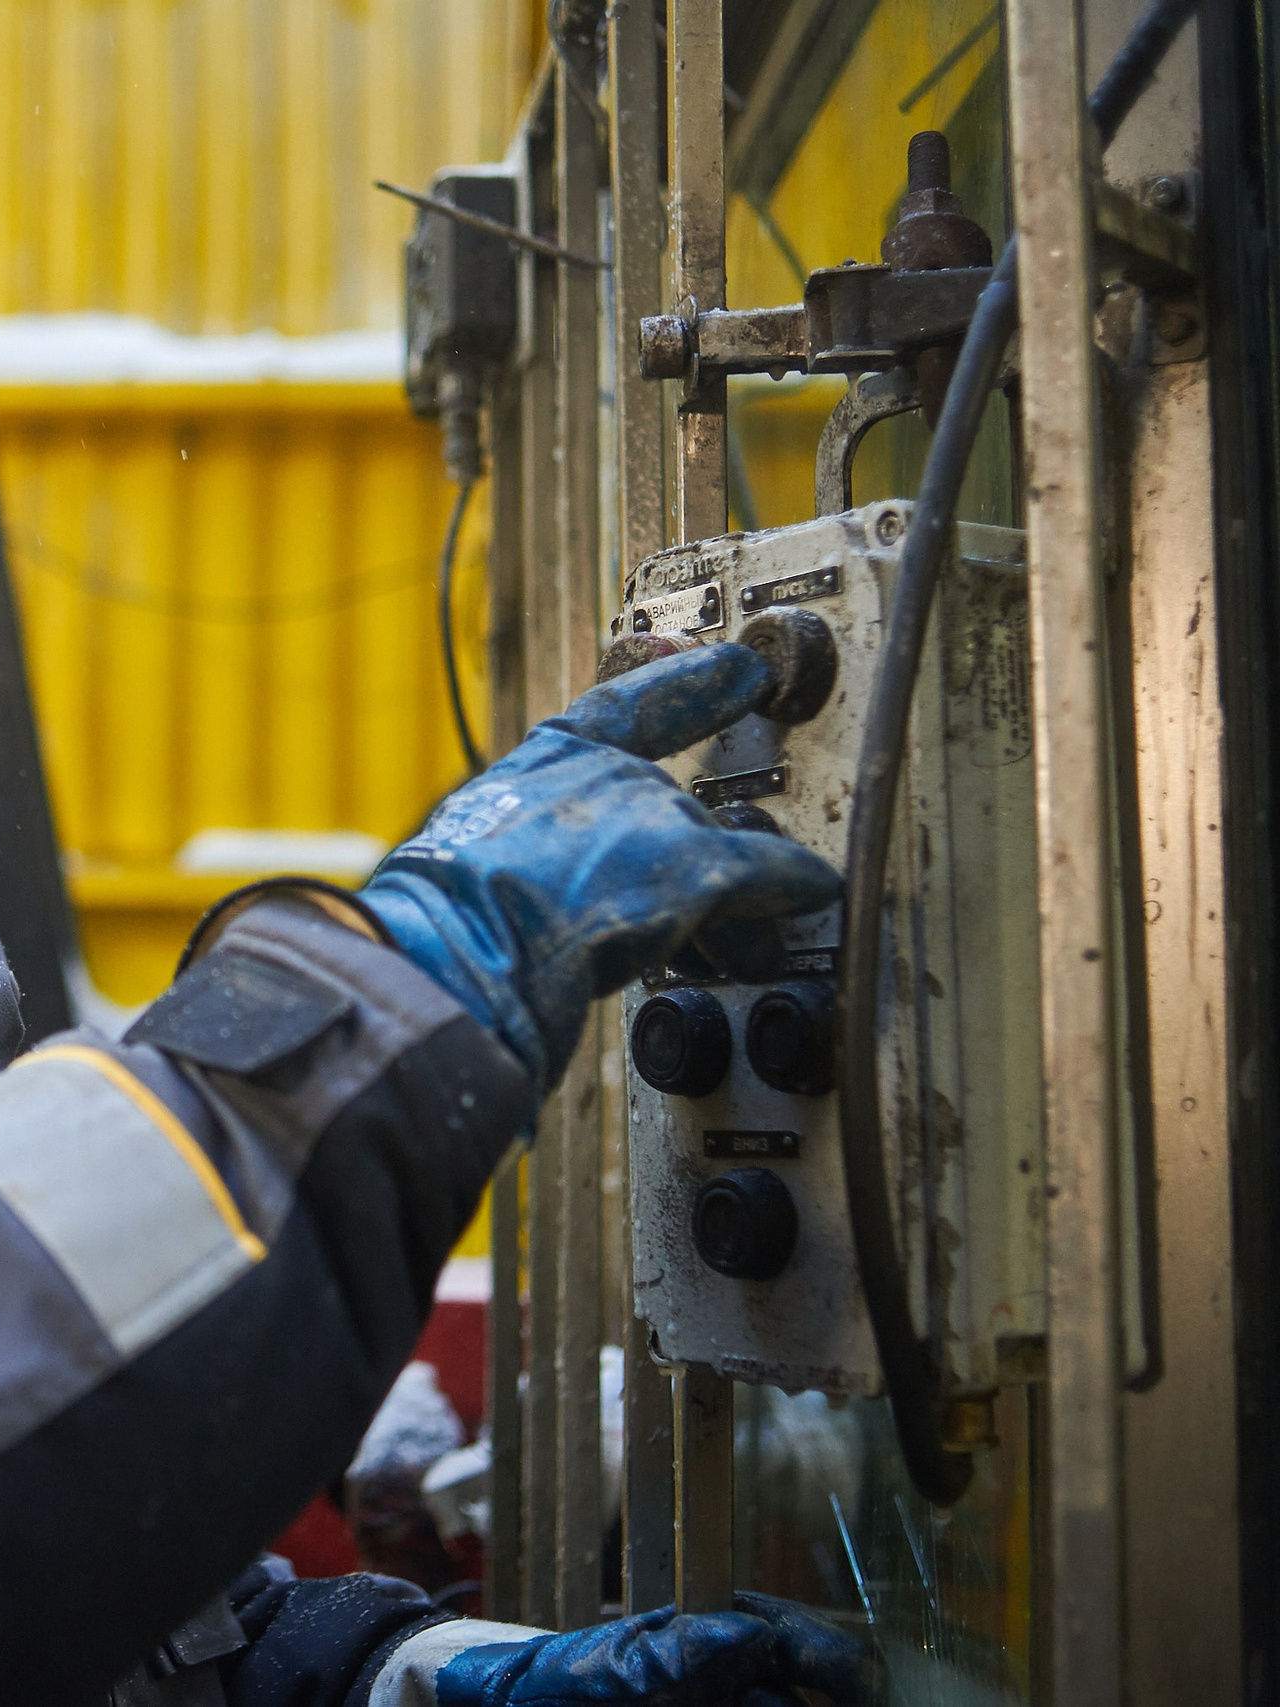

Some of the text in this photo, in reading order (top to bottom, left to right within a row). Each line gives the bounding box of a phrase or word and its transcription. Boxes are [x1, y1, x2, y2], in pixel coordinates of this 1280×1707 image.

[772, 579, 808, 600] ПУСК
[646, 591, 706, 620] АВАРИЙНЫЙ
[786, 953, 832, 971] ПЕРЕД
[732, 1136, 769, 1152] ВНИЗ
